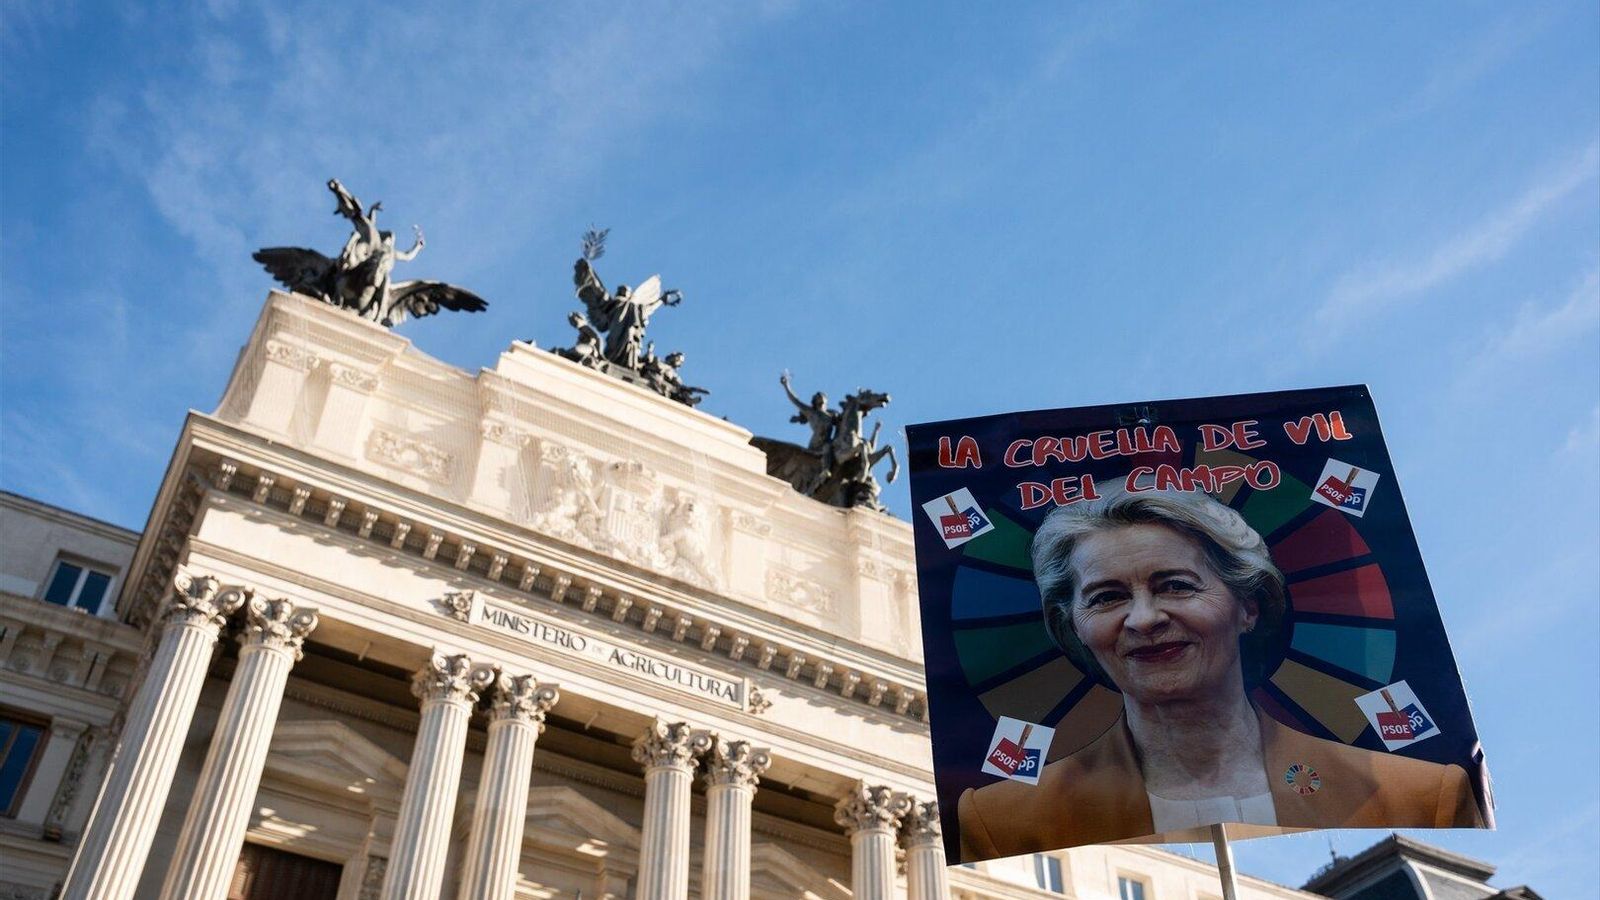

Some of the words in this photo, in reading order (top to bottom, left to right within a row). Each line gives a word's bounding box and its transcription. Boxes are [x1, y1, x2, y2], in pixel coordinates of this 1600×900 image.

[939, 435, 983, 469] LA
[1004, 425, 1181, 468] CRUELLA
[1198, 419, 1267, 452] DE
[1283, 410, 1353, 445] VIL
[1016, 473, 1102, 510] DEL
[1125, 460, 1281, 494] CAMPO
[1320, 483, 1345, 502] PSOE
[944, 523, 969, 535] PSOE
[481, 605, 587, 652] MINISTERIO
[608, 648, 737, 702] AGRICULTURA
[1381, 724, 1411, 735] PSOE
[992, 749, 1018, 770] PSOE
